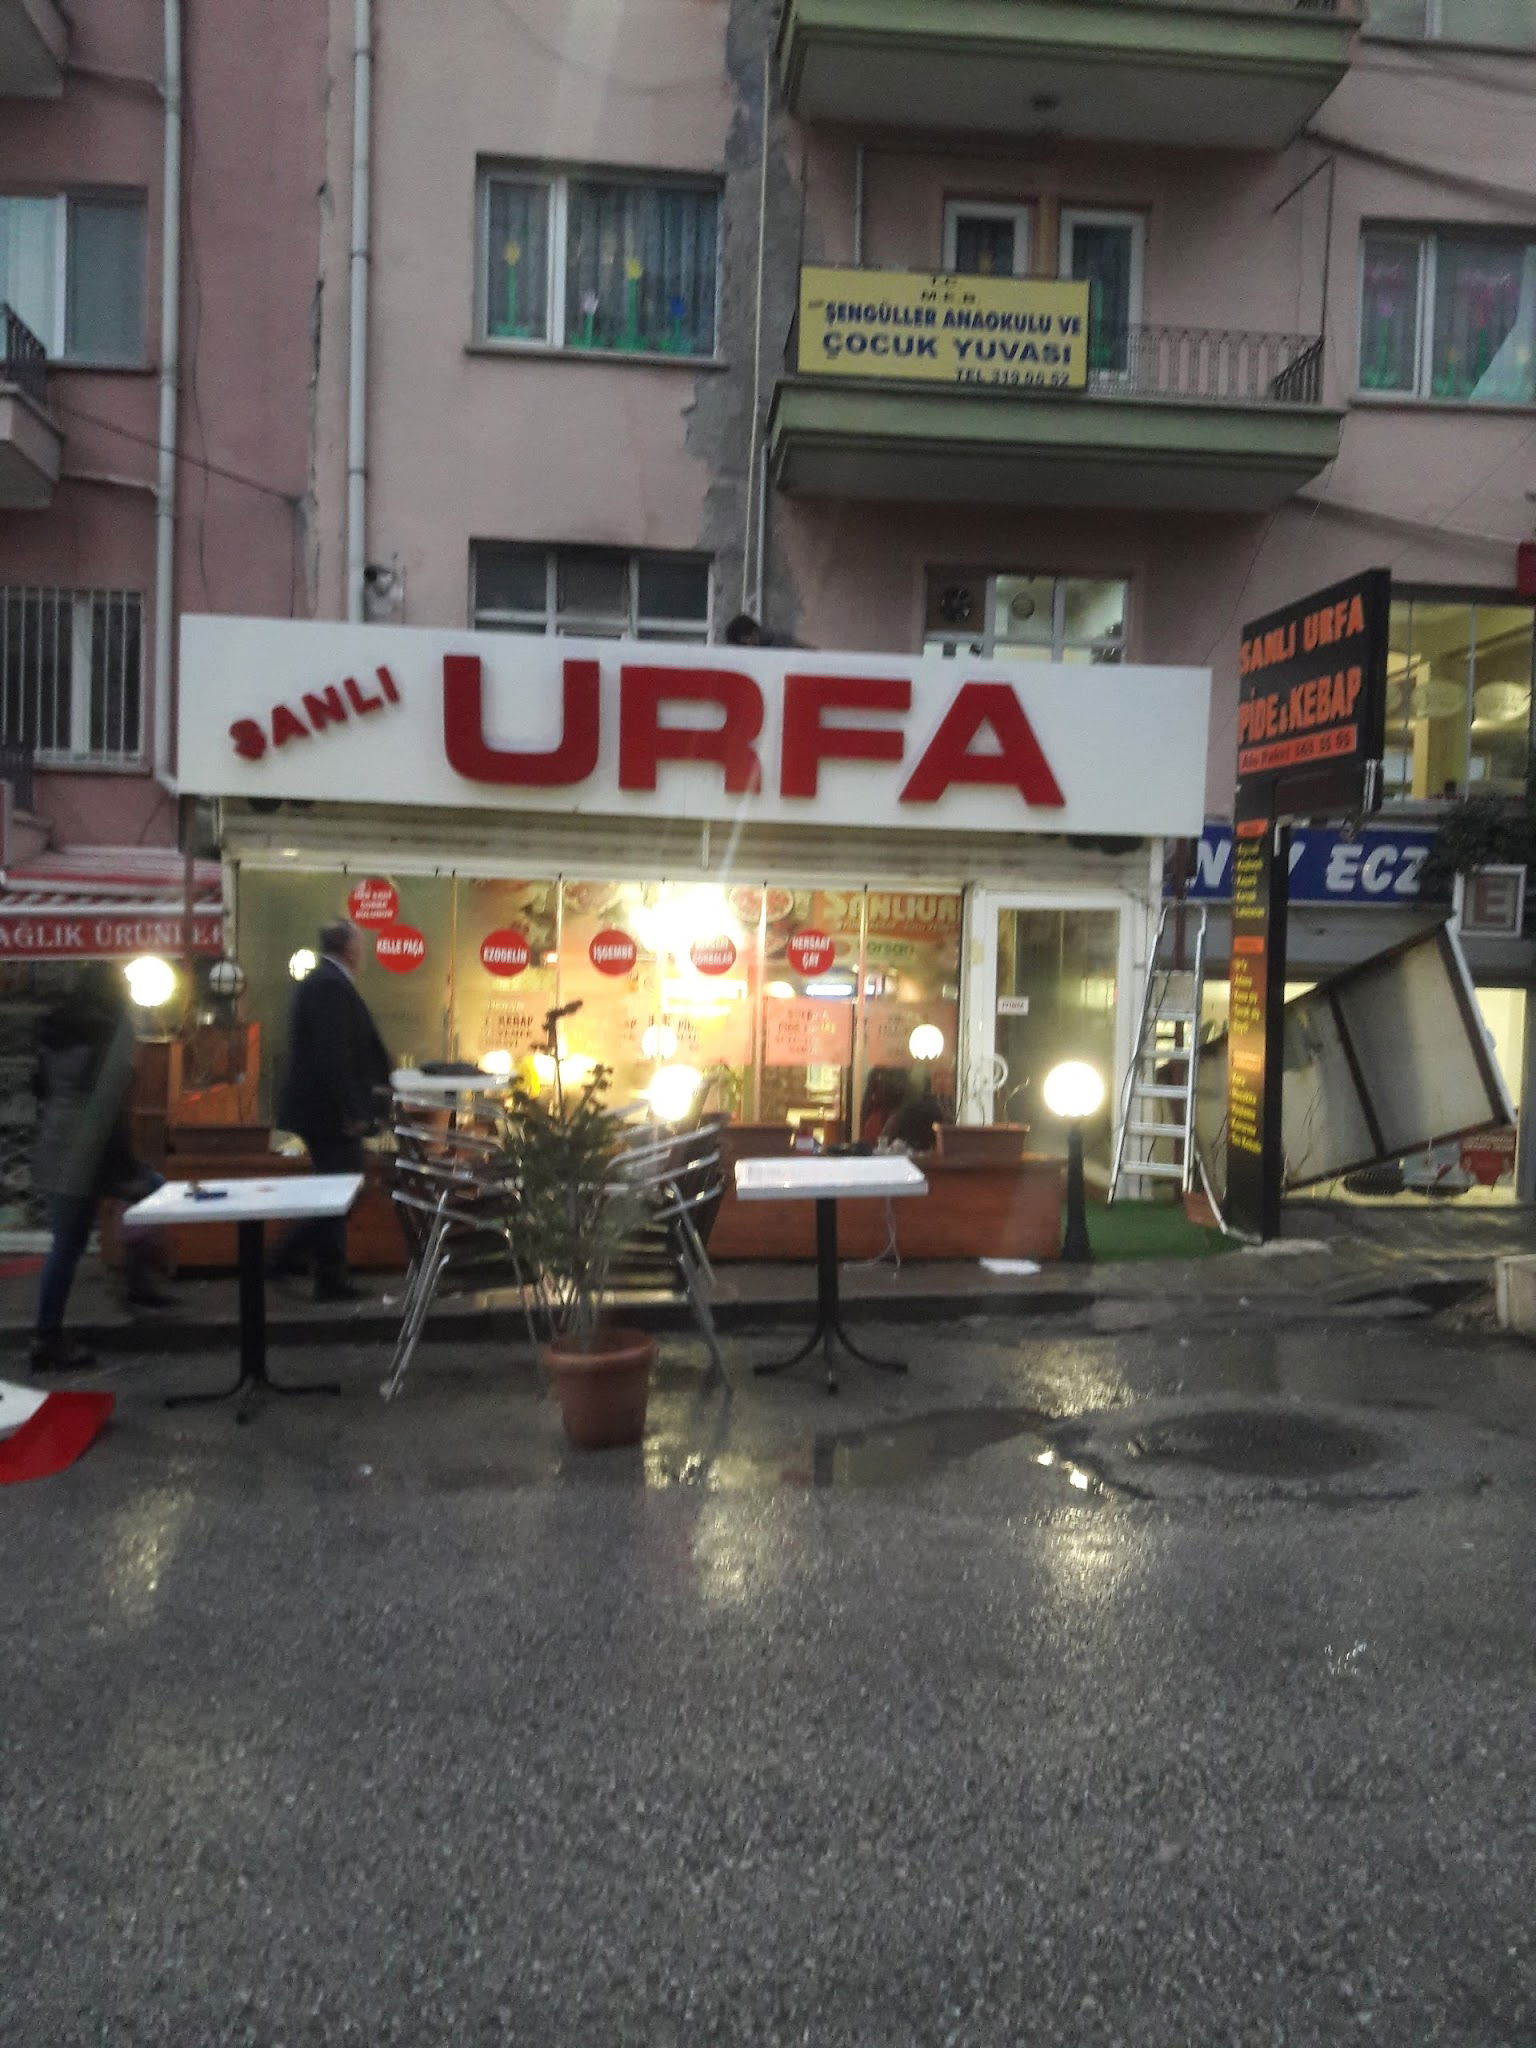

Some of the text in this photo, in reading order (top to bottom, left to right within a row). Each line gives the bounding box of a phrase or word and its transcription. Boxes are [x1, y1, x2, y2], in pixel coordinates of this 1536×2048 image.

[825, 300, 1081, 337] ŞENGÜLLER ANAOKULU VE
[822, 331, 1072, 365] ÇOCUK YUVASI
[1303, 594, 1365, 652] URFA
[1289, 666, 1361, 731] KEBAP
[443, 655, 1066, 807] URFA
[376, 937, 425, 957] KELLE PAÇA
